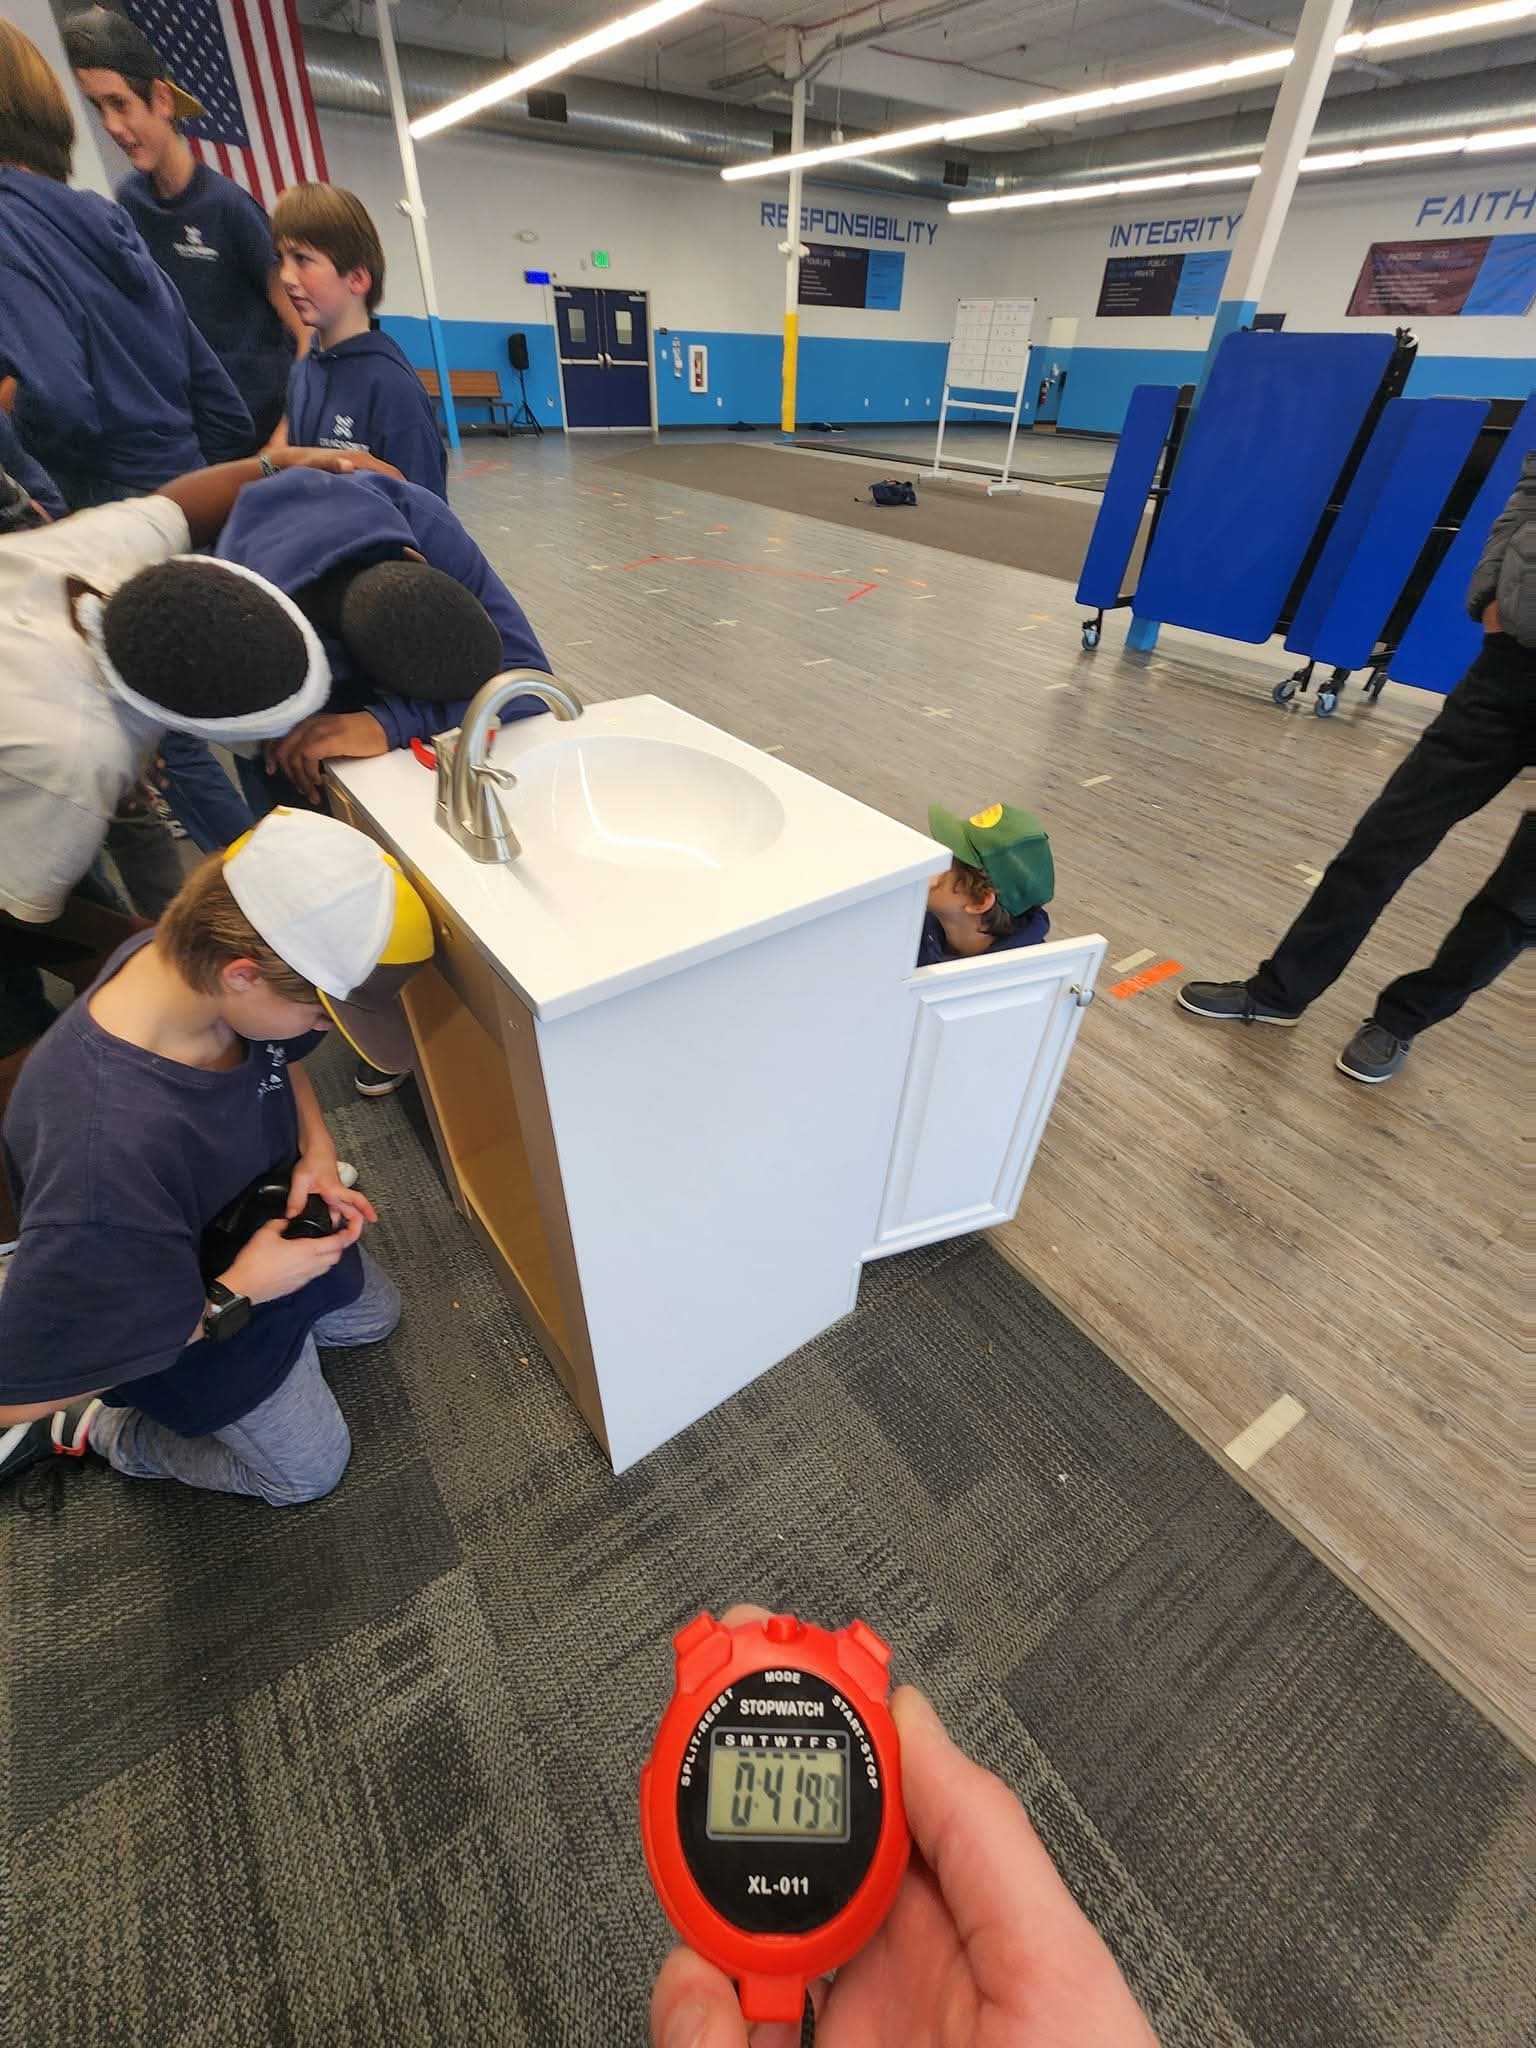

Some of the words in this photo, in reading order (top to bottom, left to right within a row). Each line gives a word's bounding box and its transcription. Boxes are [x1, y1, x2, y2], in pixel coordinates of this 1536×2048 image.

[1415, 187, 1536, 227] FAITH
[1109, 215, 1244, 248] INTEGRITY
[764, 1670, 801, 1684] MODE
[739, 1698, 824, 1718] STOPWATCH
[747, 1875, 809, 1896] XL-011
